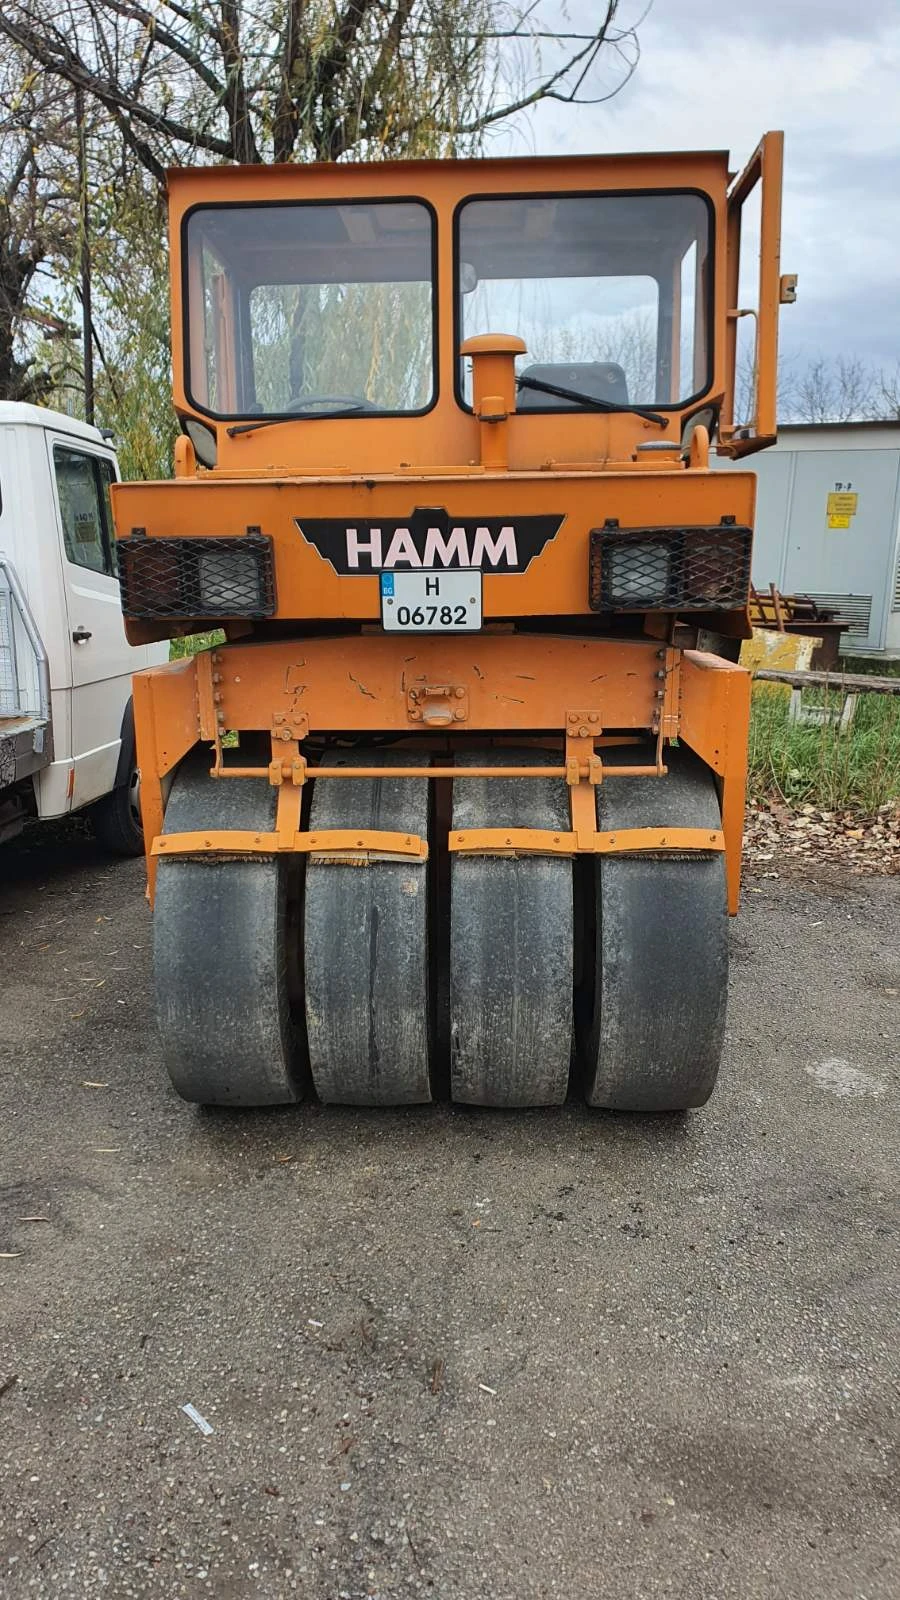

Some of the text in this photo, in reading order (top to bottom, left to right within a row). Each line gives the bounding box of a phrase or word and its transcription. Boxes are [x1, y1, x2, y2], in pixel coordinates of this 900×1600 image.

[345, 526, 519, 568] HAMM
[383, 587, 393, 595] BG
[425, 576, 440, 596] H
[397, 605, 467, 626] 06782
